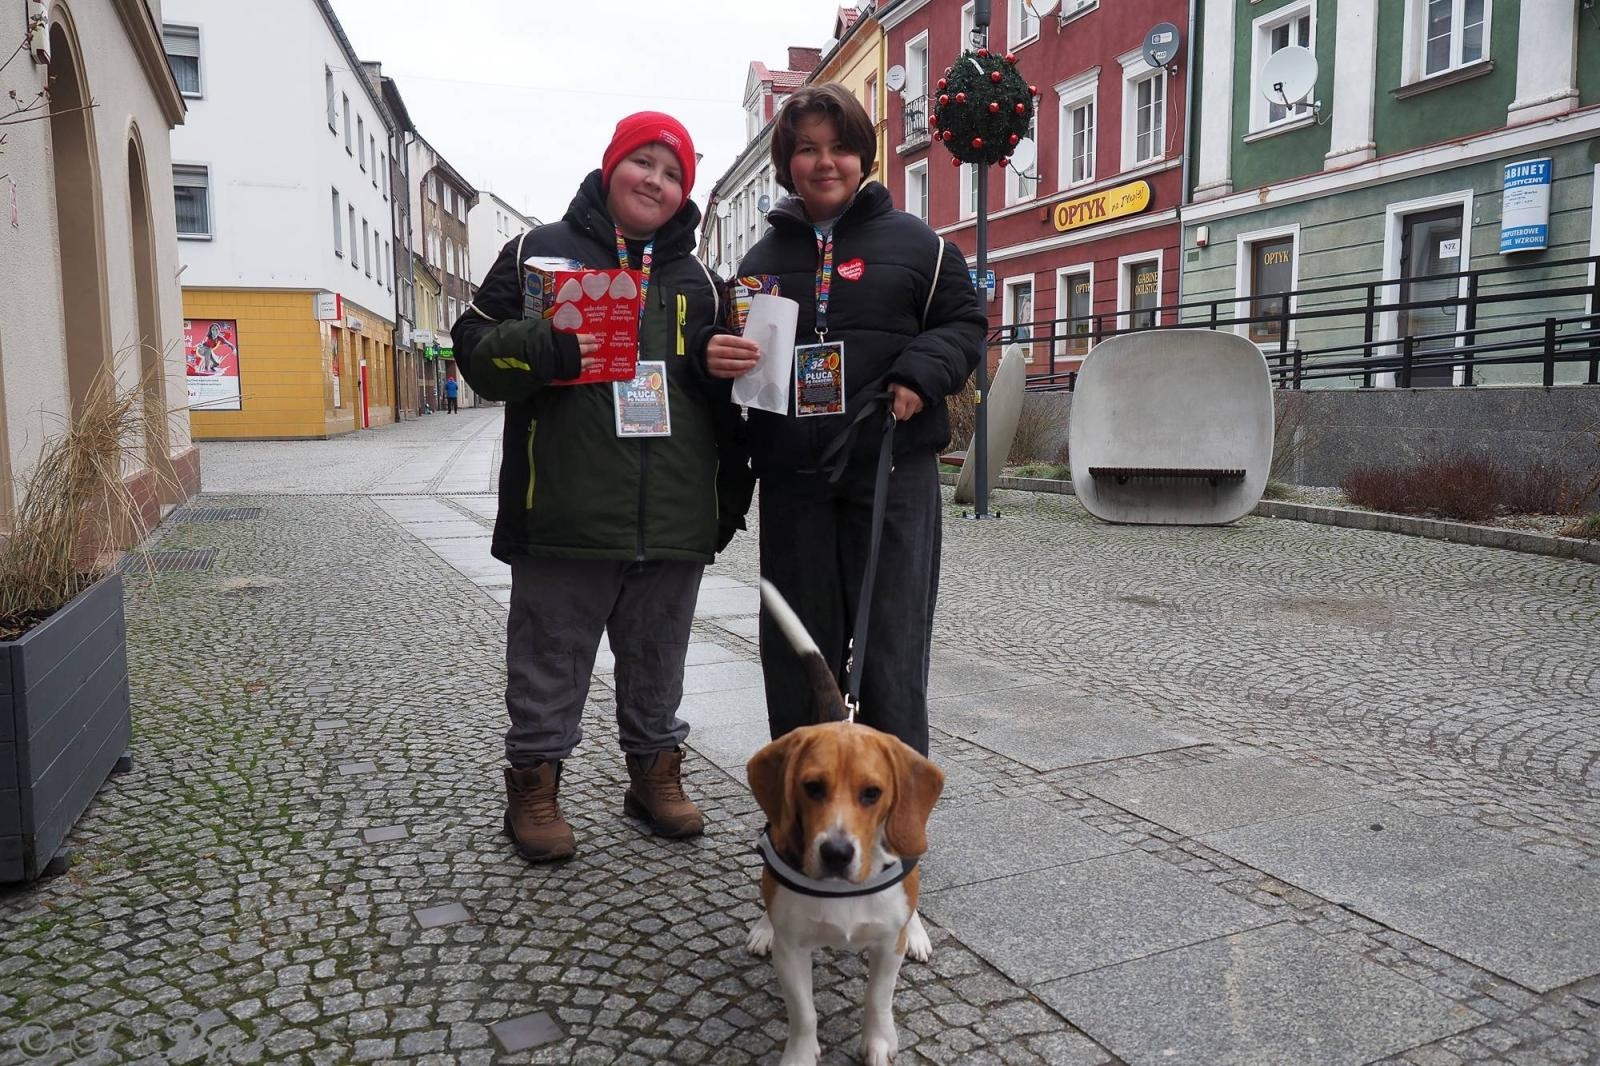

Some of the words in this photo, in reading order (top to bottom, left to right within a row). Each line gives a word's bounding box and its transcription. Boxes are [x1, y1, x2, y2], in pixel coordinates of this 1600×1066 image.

[1504, 177, 1544, 189] LISTYCZNY
[1058, 196, 1106, 227] OPTYK
[1264, 250, 1289, 265] OPTYK
[1137, 272, 1158, 284] GABINE
[806, 371, 833, 381] PŁUCA
[627, 390, 656, 398] PŁUCA
